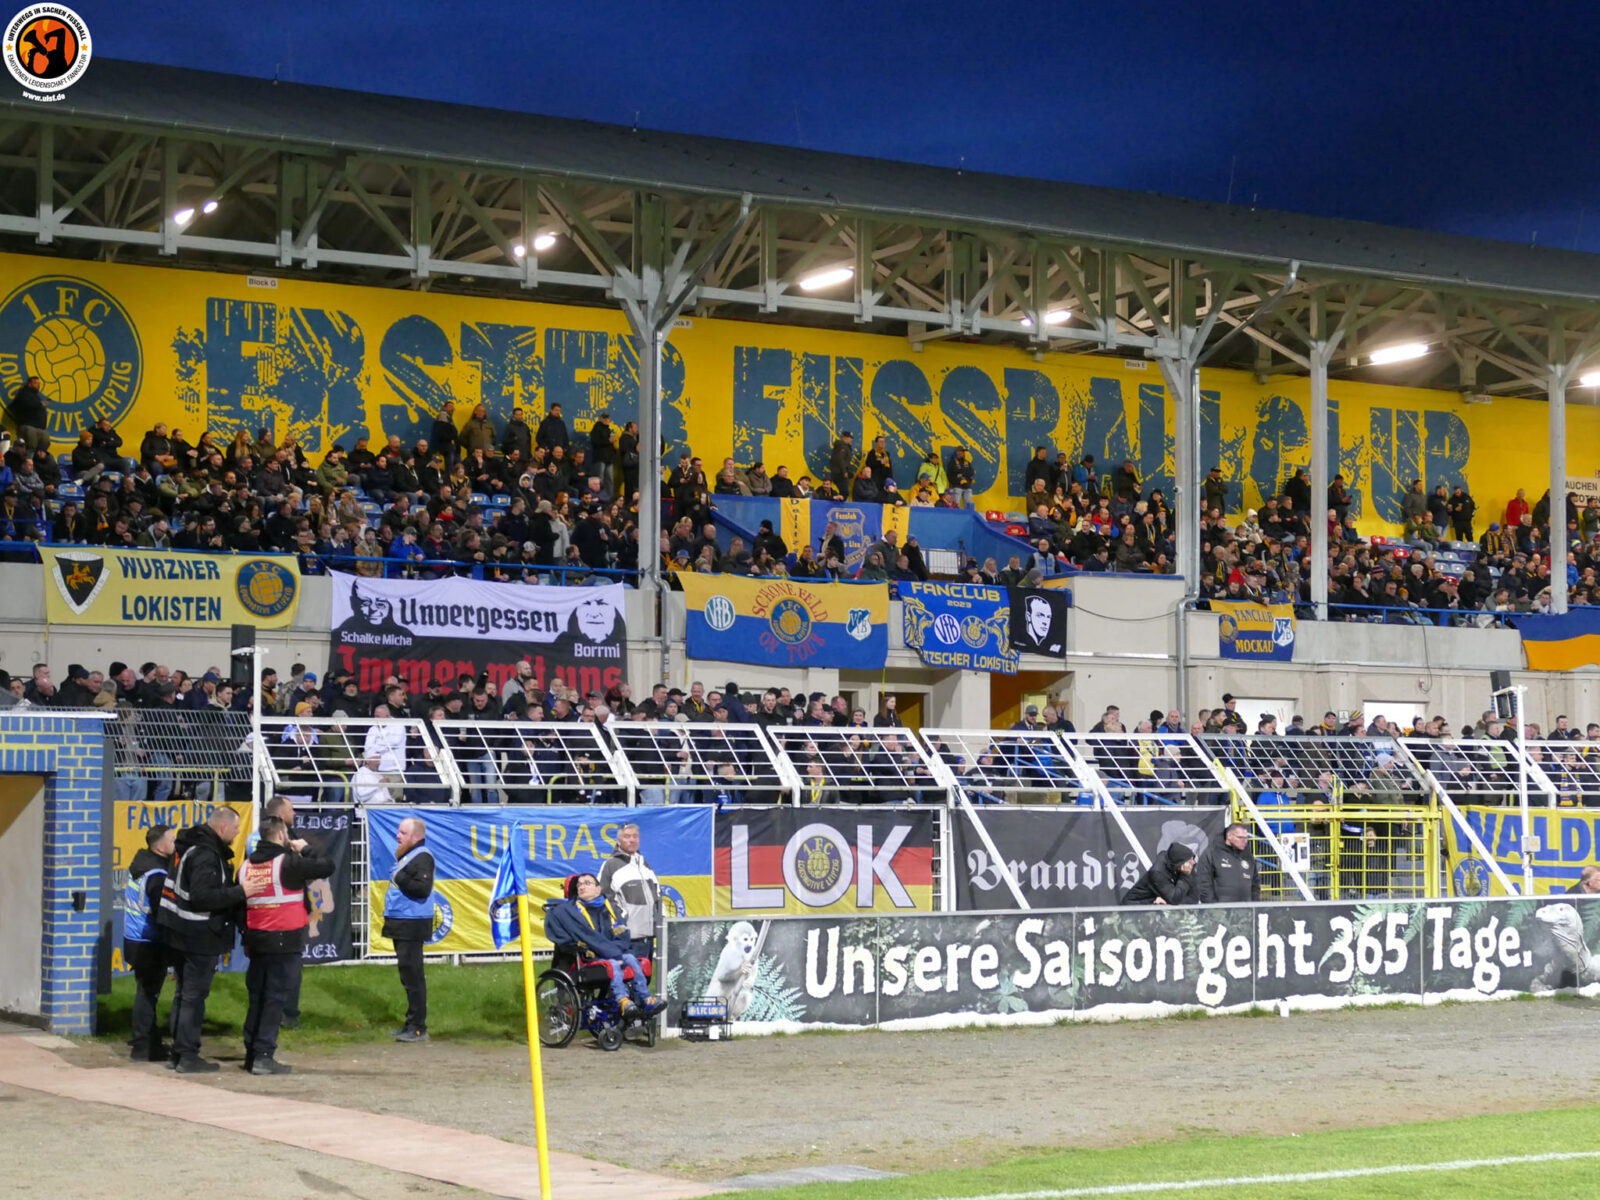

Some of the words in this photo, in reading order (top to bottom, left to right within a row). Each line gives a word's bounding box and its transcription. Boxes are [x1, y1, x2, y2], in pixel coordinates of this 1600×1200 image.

[249, 278, 268, 286] Block
[22, 286, 111, 326] 1.FC
[88, 360, 133, 421] LEIPZIG
[1564, 481, 1598, 491] AUCHEN
[117, 555, 220, 580] WURZNER
[911, 583, 1000, 602] FANCLUB
[947, 600, 972, 608] 2023
[121, 594, 222, 622] LOKISTEN
[398, 597, 559, 636] Unvergessen
[706, 599, 732, 629] VfB
[1234, 610, 1273, 623] FANCLUB
[341, 630, 381, 645] Schalke
[382, 632, 412, 647] Micha
[935, 616, 960, 644] VfB
[574, 642, 621, 659] Borrmi
[786, 633, 826, 664] TOUR
[1235, 640, 1274, 653] MOCKAU
[974, 654, 1018, 673] LOKISTEN
[291, 814, 348, 831] LDEN
[1451, 808, 1600, 862] WALD
[731, 824, 917, 909] LOK
[967, 849, 1141, 891] Brandis
[806, 926, 1000, 998] Unsere
[1014, 916, 1184, 992] Saison
[1196, 913, 1315, 1007] geht
[1325, 911, 1408, 982] 365
[1425, 906, 1532, 994] Tage.
